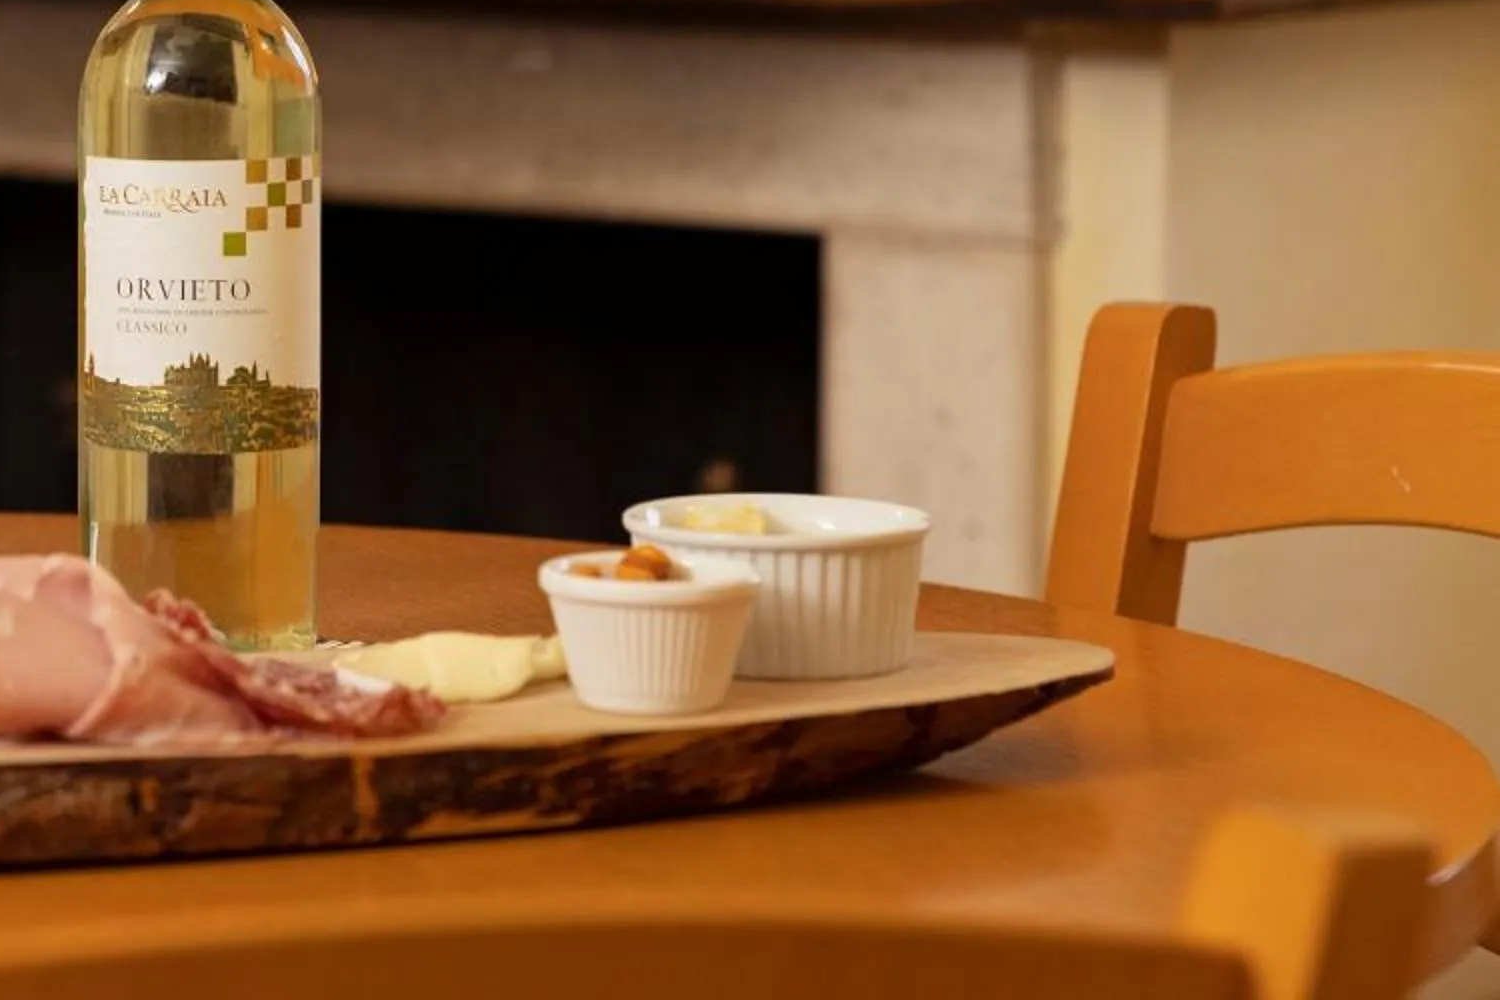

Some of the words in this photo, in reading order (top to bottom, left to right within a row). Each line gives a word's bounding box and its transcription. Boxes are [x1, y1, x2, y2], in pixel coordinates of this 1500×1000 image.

[99, 185, 119, 204] LA
[116, 278, 251, 301] ORVIETO
[116, 320, 188, 336] CLASSICO
